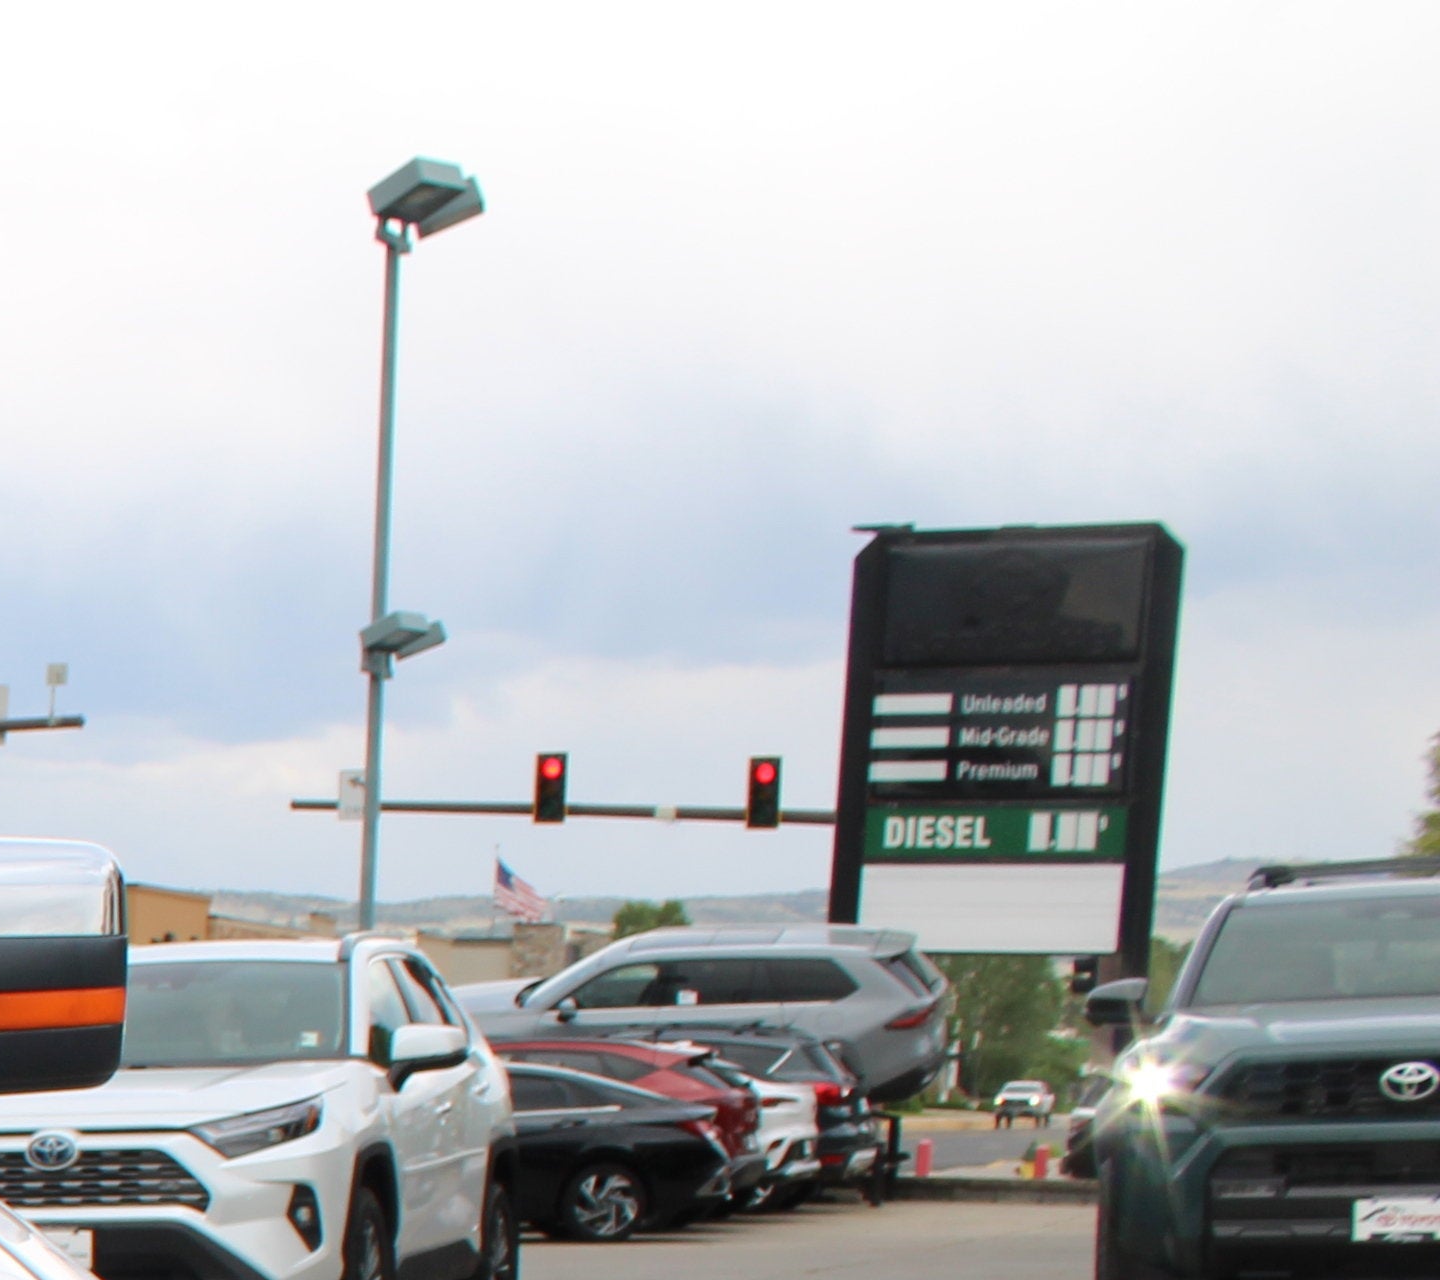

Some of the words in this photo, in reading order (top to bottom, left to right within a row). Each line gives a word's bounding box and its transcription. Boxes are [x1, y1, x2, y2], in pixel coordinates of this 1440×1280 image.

[960, 693, 1047, 715] Unleaded
[958, 725, 1050, 748] Mid-Grade
[956, 759, 1039, 780] Premium
[882, 815, 992, 849] DIESEL
